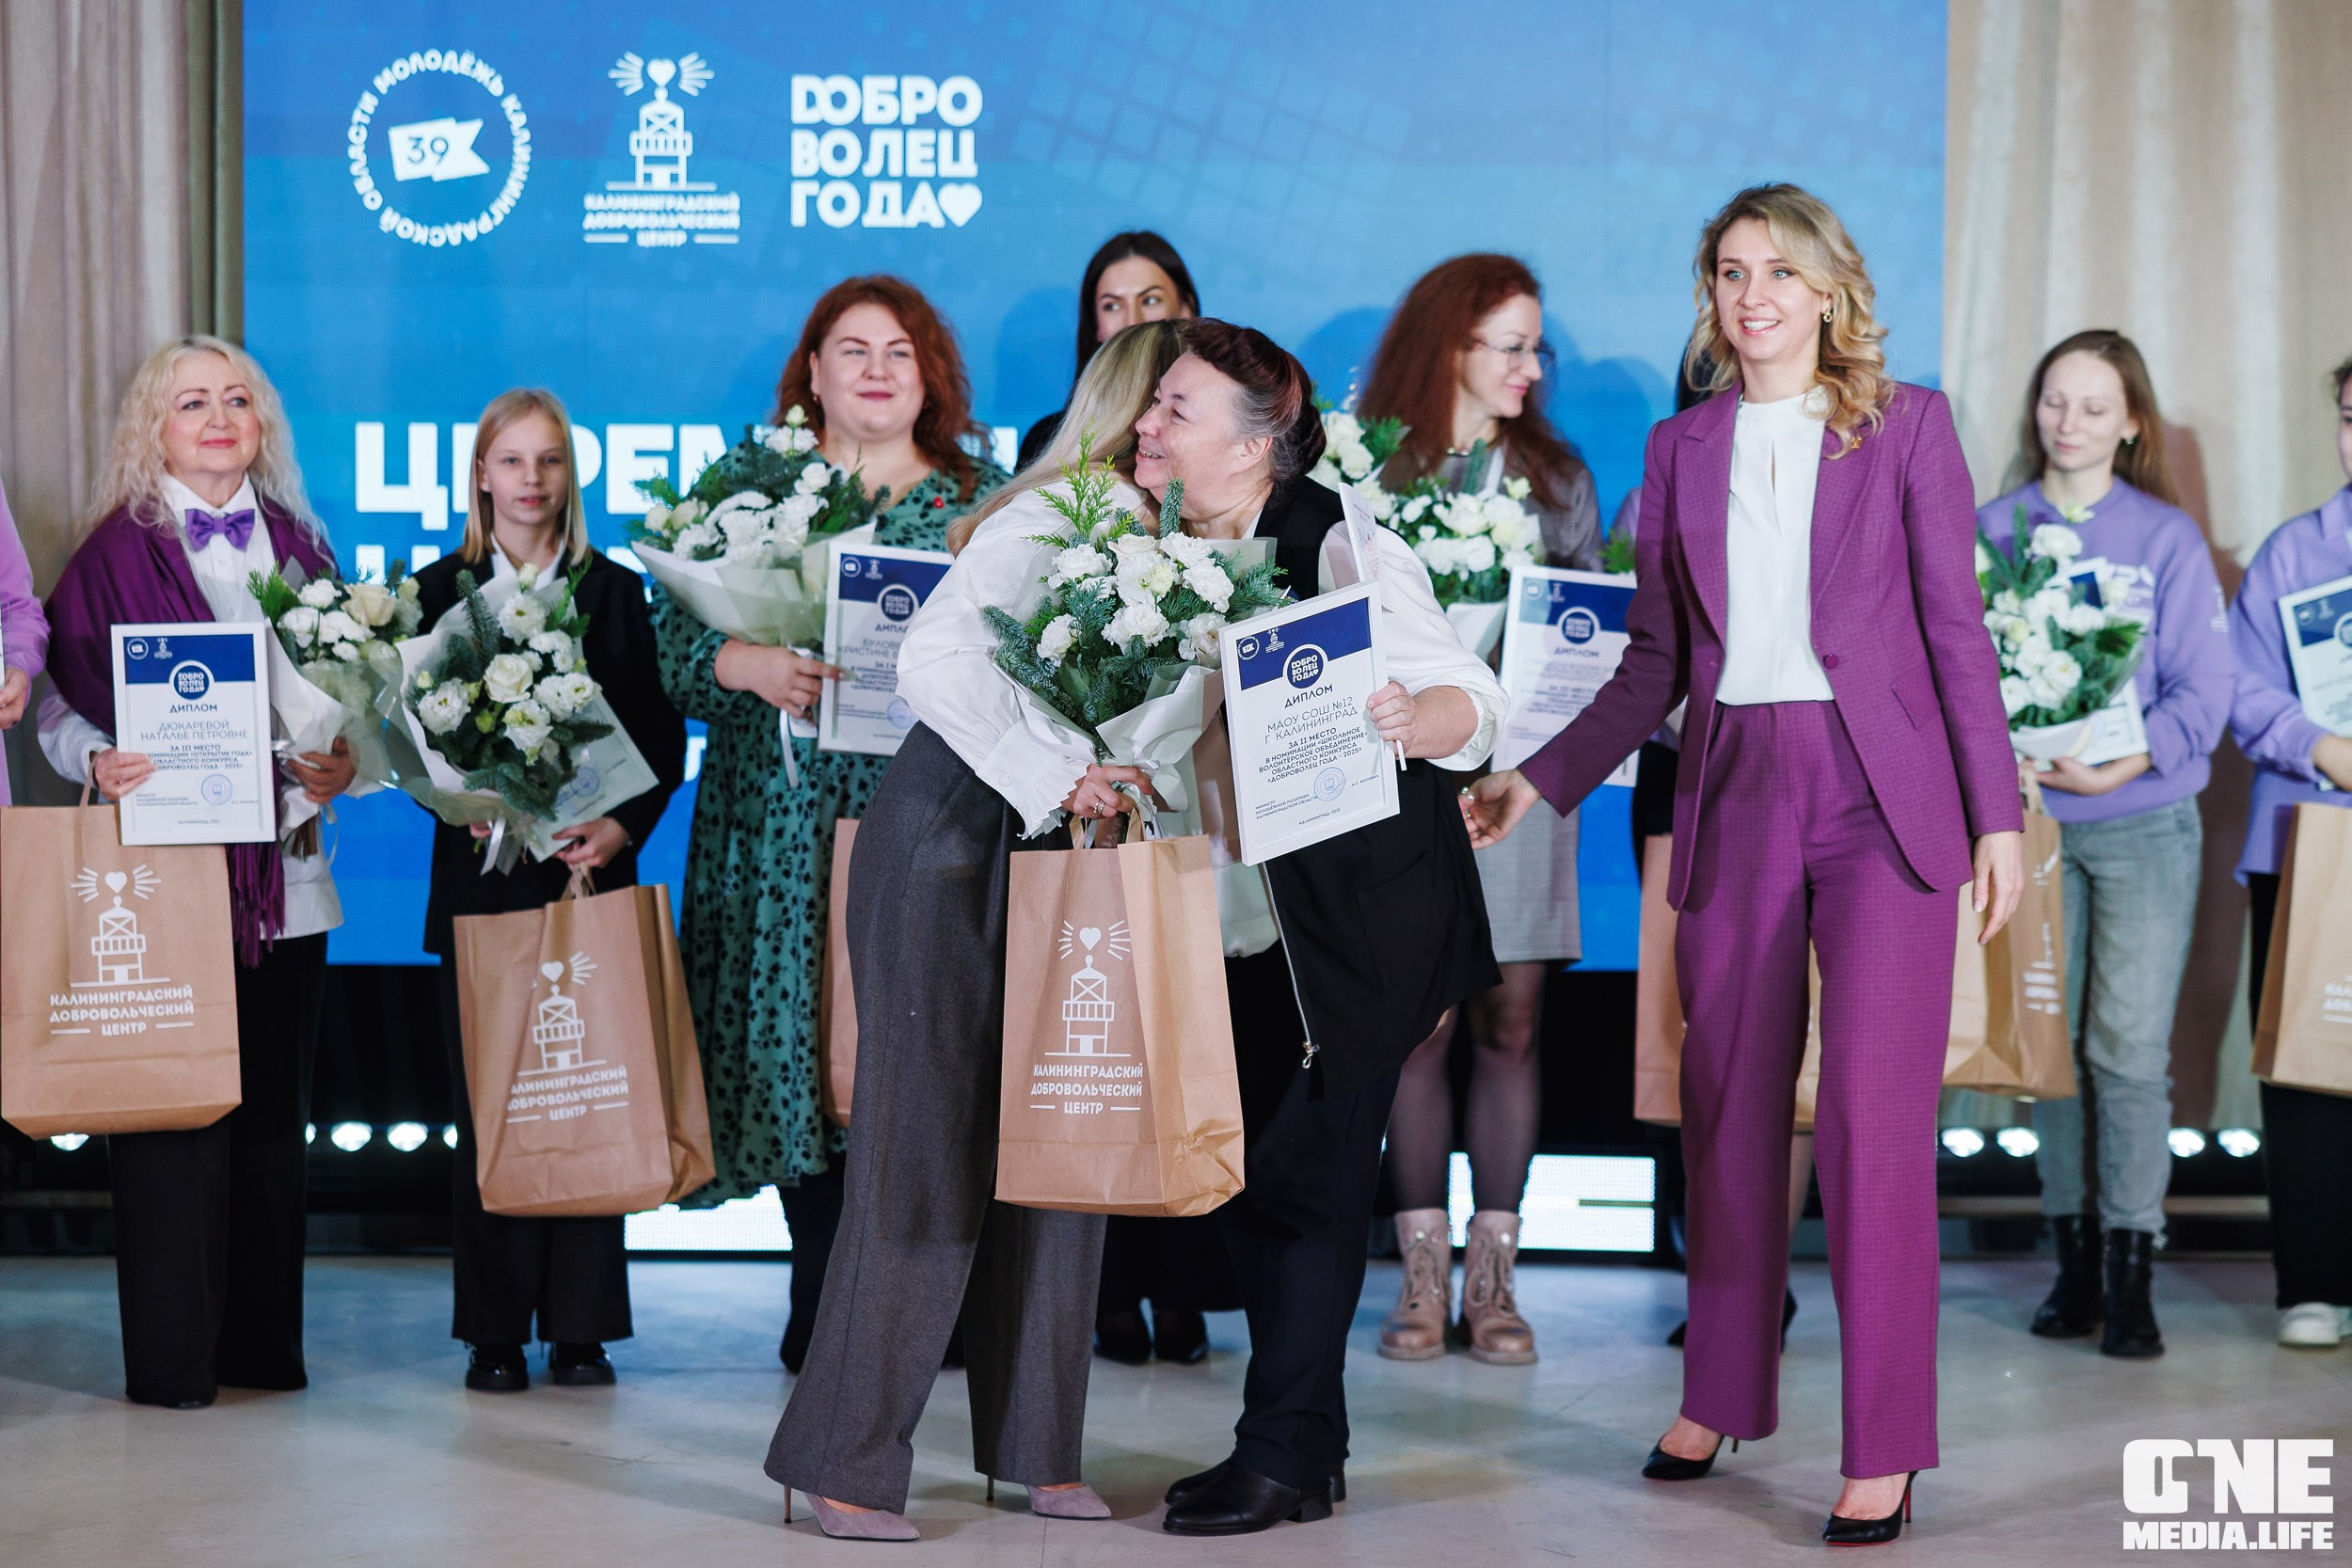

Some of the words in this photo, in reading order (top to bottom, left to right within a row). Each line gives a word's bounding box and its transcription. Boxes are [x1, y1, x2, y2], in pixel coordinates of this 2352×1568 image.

[408, 136, 450, 165] 39
[791, 127, 978, 178] ВОЛЕЦ
[791, 179, 946, 229] ГОДА
[875, 624, 909, 633] ДИПЛ
[1292, 662, 1317, 676] ВОЛЕЦ
[1285, 684, 1333, 708] ДИПЛОМ
[169, 704, 218, 714] ДИПЛОМ
[1267, 715, 1299, 733] МАОУ
[1302, 705, 1329, 721] СОШ
[1332, 696, 1353, 710] №12
[159, 719, 230, 732] ДЮКАРЕВОЙ
[1276, 706, 1359, 740] КАЛИНИНГРАД
[141, 732, 189, 741] НАТАЛЬЕ
[192, 730, 248, 740] ПЕТРОВНЕ
[1272, 742, 1316, 762] НОМИНАЦИИ
[1317, 726, 1360, 744] «ШКОЛЬНОЕ
[1288, 741, 1298, 750] ЗА
[1309, 728, 1337, 741] МЕСТО
[1259, 749, 1313, 772] ВОЛОНТЁРСКОЕ
[1315, 732, 1368, 752] ОБЪЕДИНЕНИЕ»
[1271, 755, 1318, 775] ОБЛАСТНОГО
[1319, 742, 1357, 758] КОНКУРСА
[1319, 756, 1337, 766] ГОДА
[50, 984, 193, 1006] КАЛИНИНГРАДСКИЙ
[50, 1000, 194, 1023] ДОБРОВОЛЬЧЕСКИЙ
[102, 1022, 147, 1036] ЦЕНТР
[511, 1065, 628, 1095] АЛИНИНГРАДСКИЙ
[1033, 1063, 1143, 1079] КАЛИНИНГРАДСКИЙ
[1031, 1082, 1142, 1097] ДОБРОВОЛЬЧЕСКИЙ
[549, 1104, 587, 1121] ЦЕНТР
[1064, 1101, 1104, 1115] ЦЕНТР
